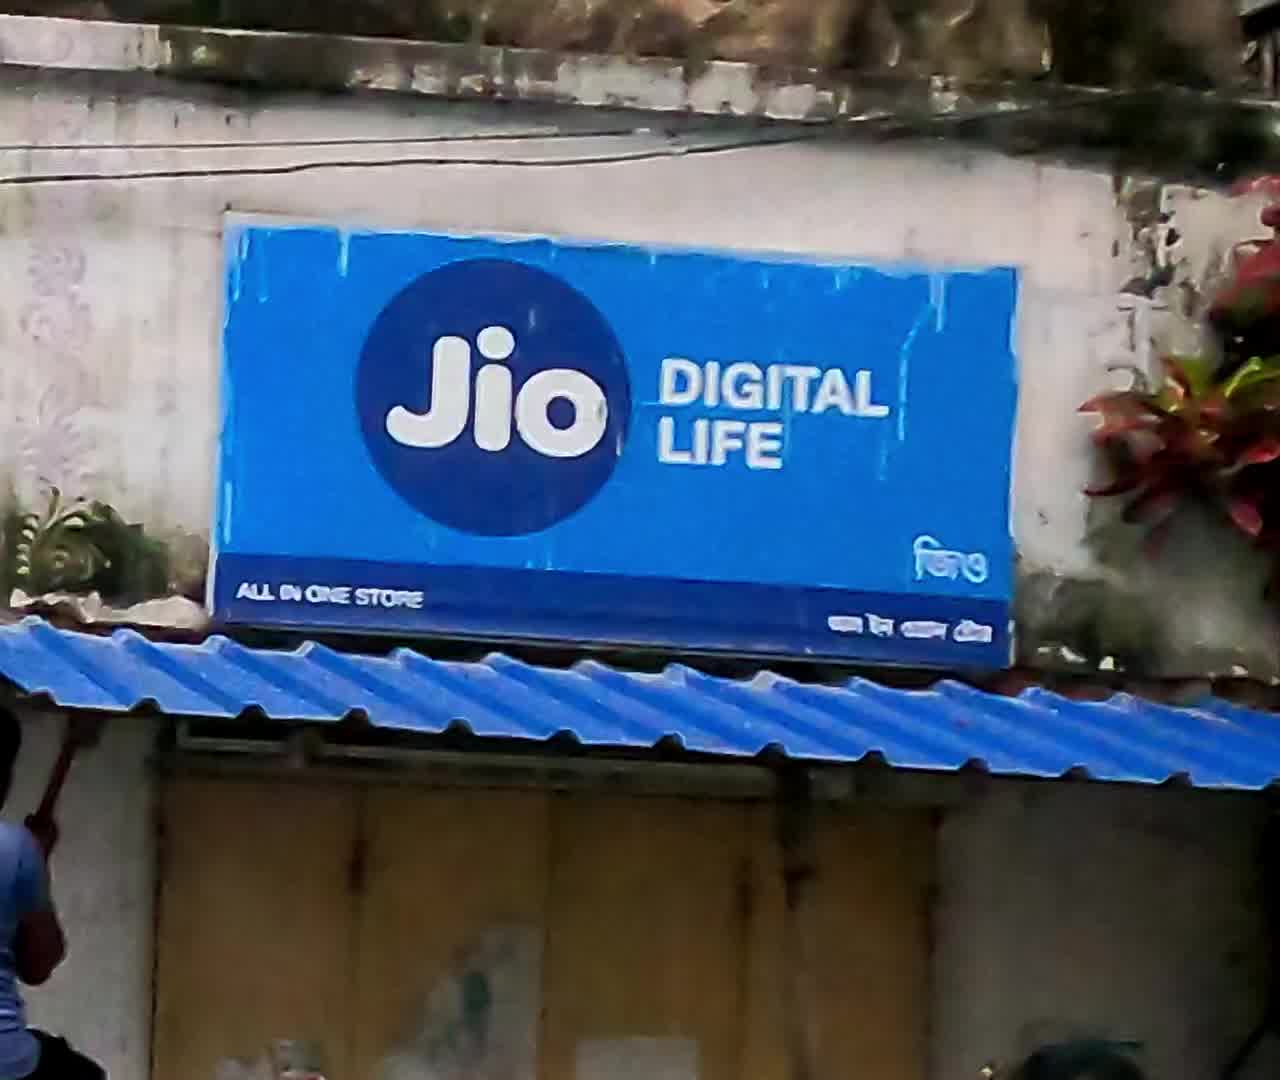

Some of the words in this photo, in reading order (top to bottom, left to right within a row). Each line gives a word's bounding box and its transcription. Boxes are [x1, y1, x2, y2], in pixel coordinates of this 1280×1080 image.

[385, 325, 609, 458] Jio
[659, 357, 890, 418] DIGITAL
[657, 415, 784, 470] LIFE
[912, 534, 989, 584] জিও
[235, 582, 276, 601] ALL
[279, 583, 302, 602] IN
[305, 584, 353, 605] ONE
[354, 587, 425, 609] STORE
